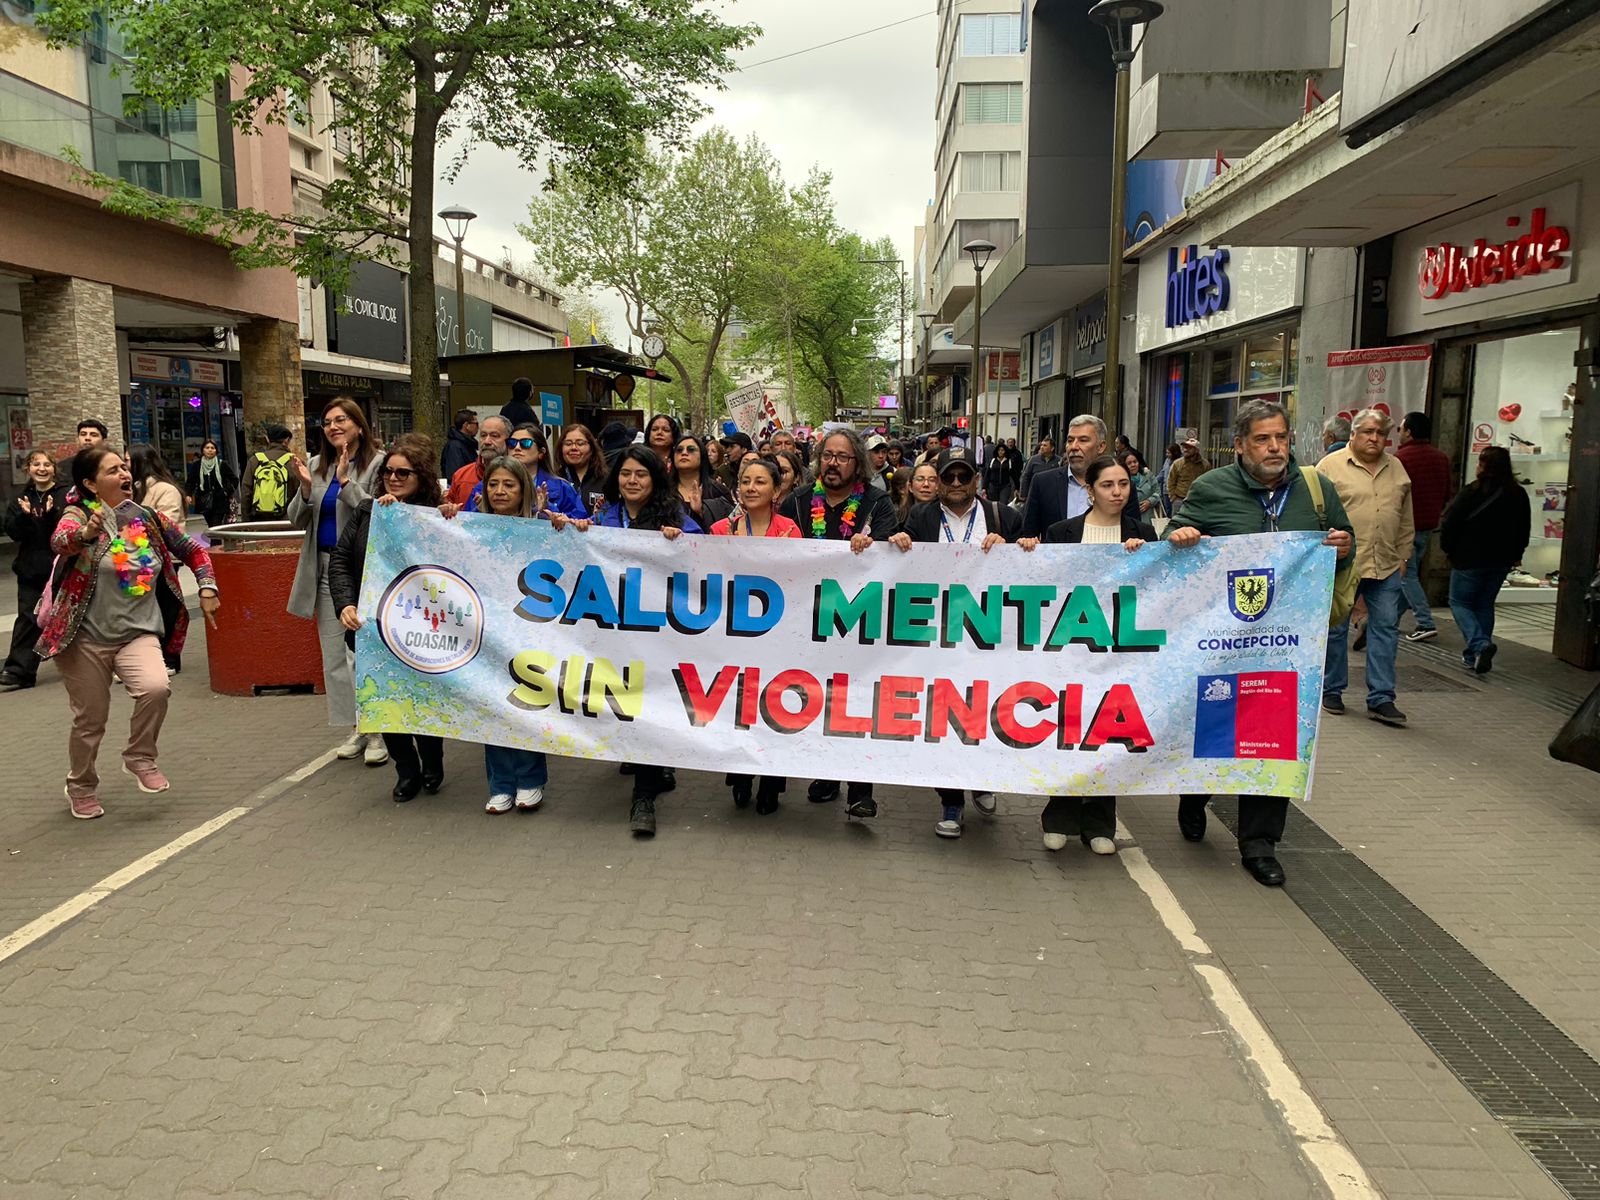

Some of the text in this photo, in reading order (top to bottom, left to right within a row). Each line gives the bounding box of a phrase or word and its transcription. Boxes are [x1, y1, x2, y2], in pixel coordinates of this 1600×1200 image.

[1165, 245, 1231, 328] hites
[379, 304, 397, 324] STORE
[319, 372, 372, 390] GALERIA PLAZA
[14, 430, 28, 443] 25
[513, 558, 1166, 653] SALUD MENTAL
[1206, 625, 1291, 638] Municipalidad de
[405, 631, 459, 652] COASAM
[1197, 633, 1299, 651] CONCEPCIÓN
[1240, 679, 1268, 688] SEREMI
[507, 650, 1156, 753] SIN VIOLENCIA
